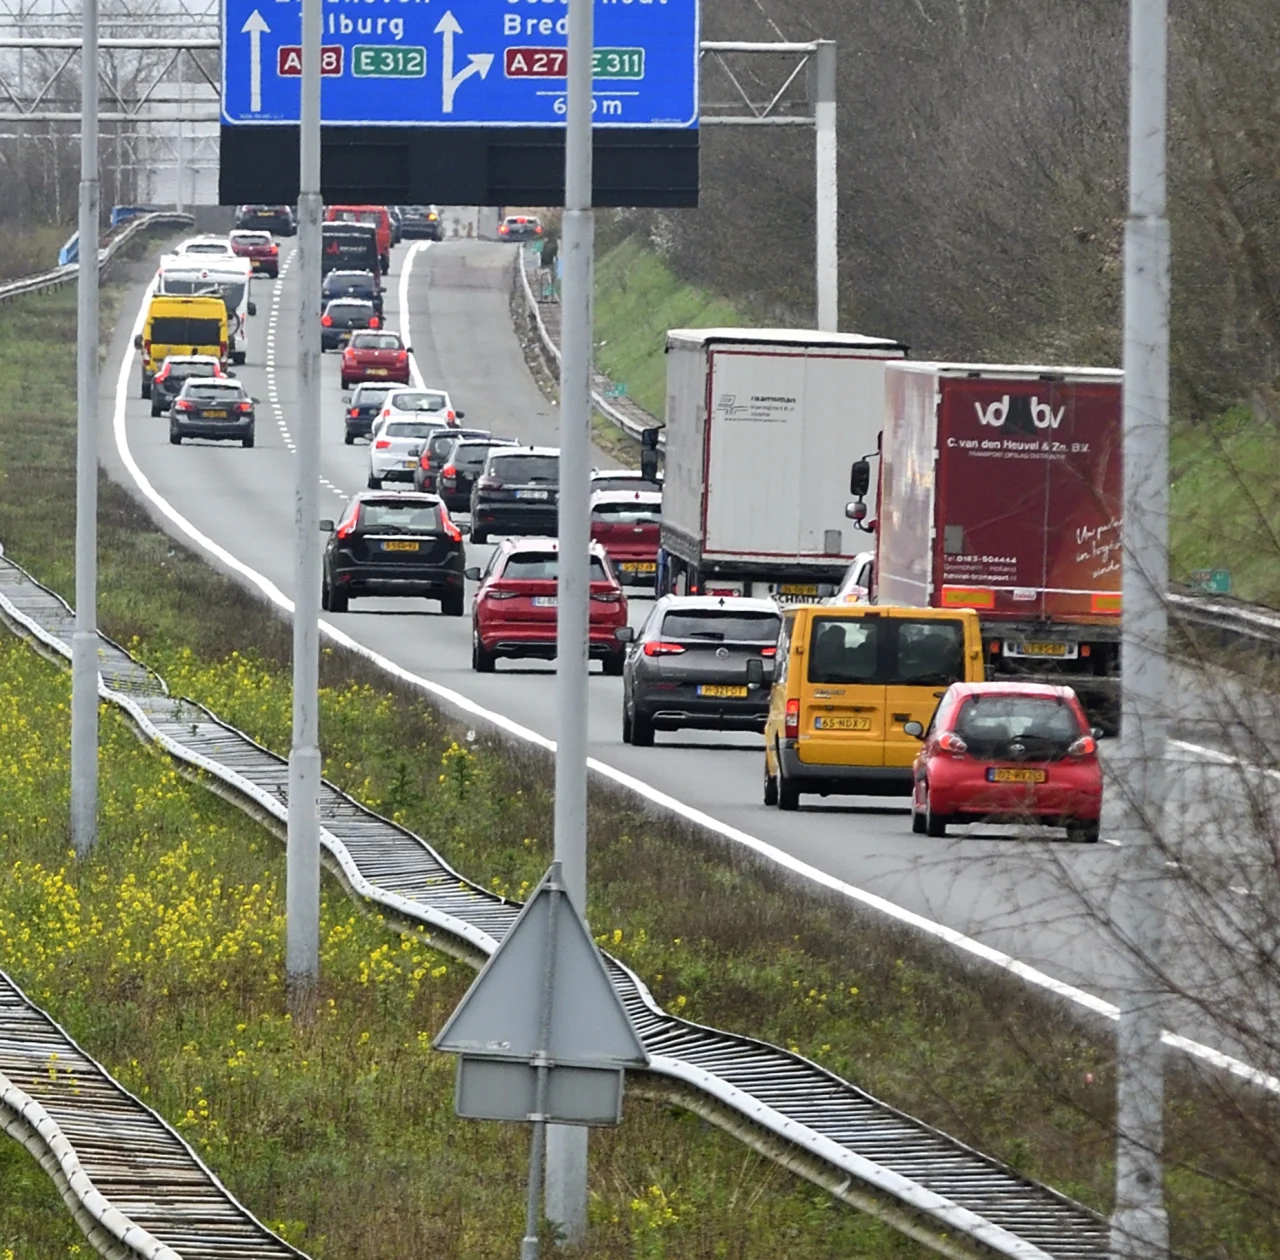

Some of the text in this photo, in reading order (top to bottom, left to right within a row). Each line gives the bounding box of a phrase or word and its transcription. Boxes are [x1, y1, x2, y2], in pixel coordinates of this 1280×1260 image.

[299, 12, 404, 40] lburg
[504, 13, 569, 35] Bred
[283, 51, 338, 71] A8
[602, 99, 623, 115] m
[959, 440, 979, 449] van
[981, 439, 1001, 450] den
[1003, 440, 1040, 451] Heuvel
